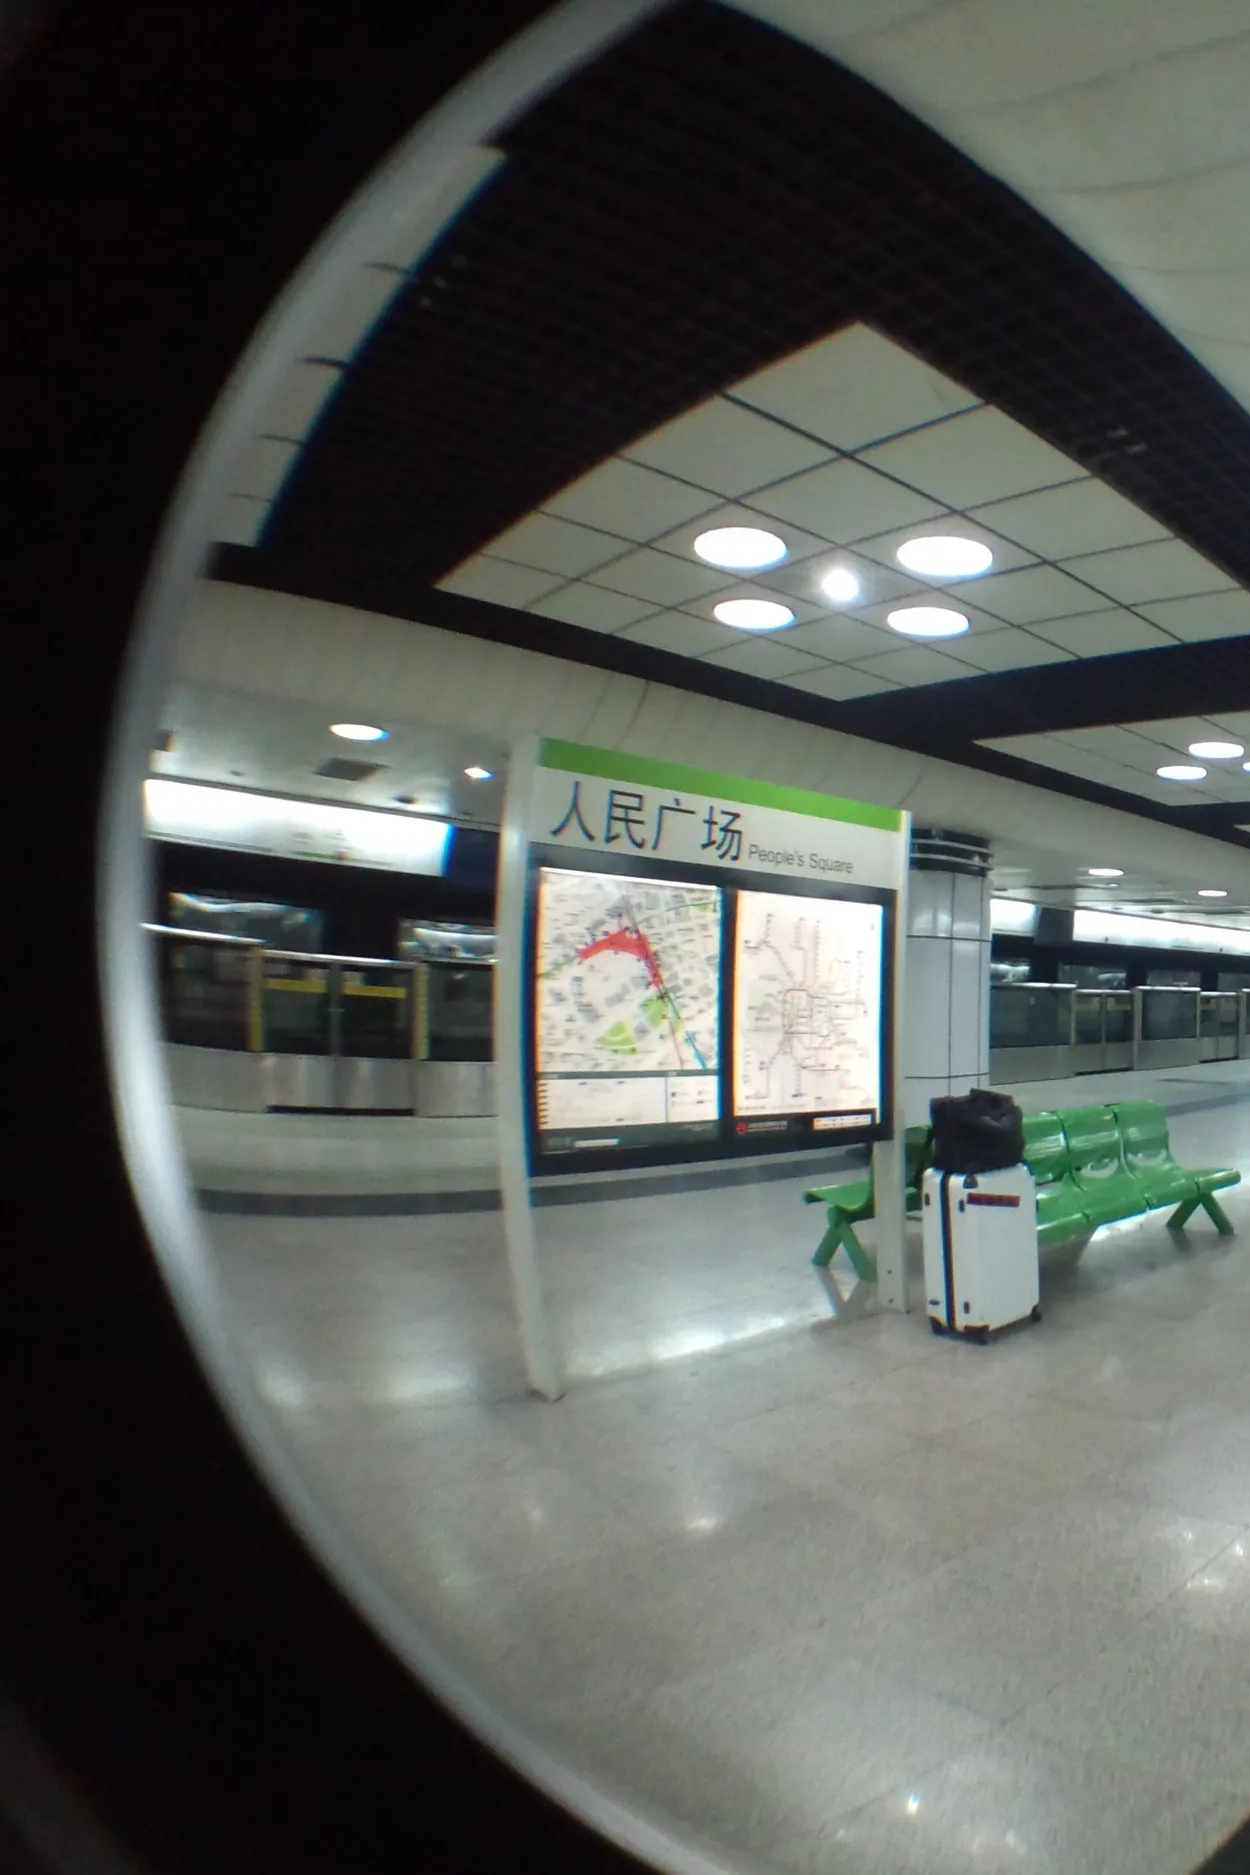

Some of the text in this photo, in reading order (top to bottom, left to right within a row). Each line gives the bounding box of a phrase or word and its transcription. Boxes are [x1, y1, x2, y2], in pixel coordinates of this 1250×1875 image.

[551, 780, 743, 861] 人民广场
[749, 844, 853, 874] People's Square
